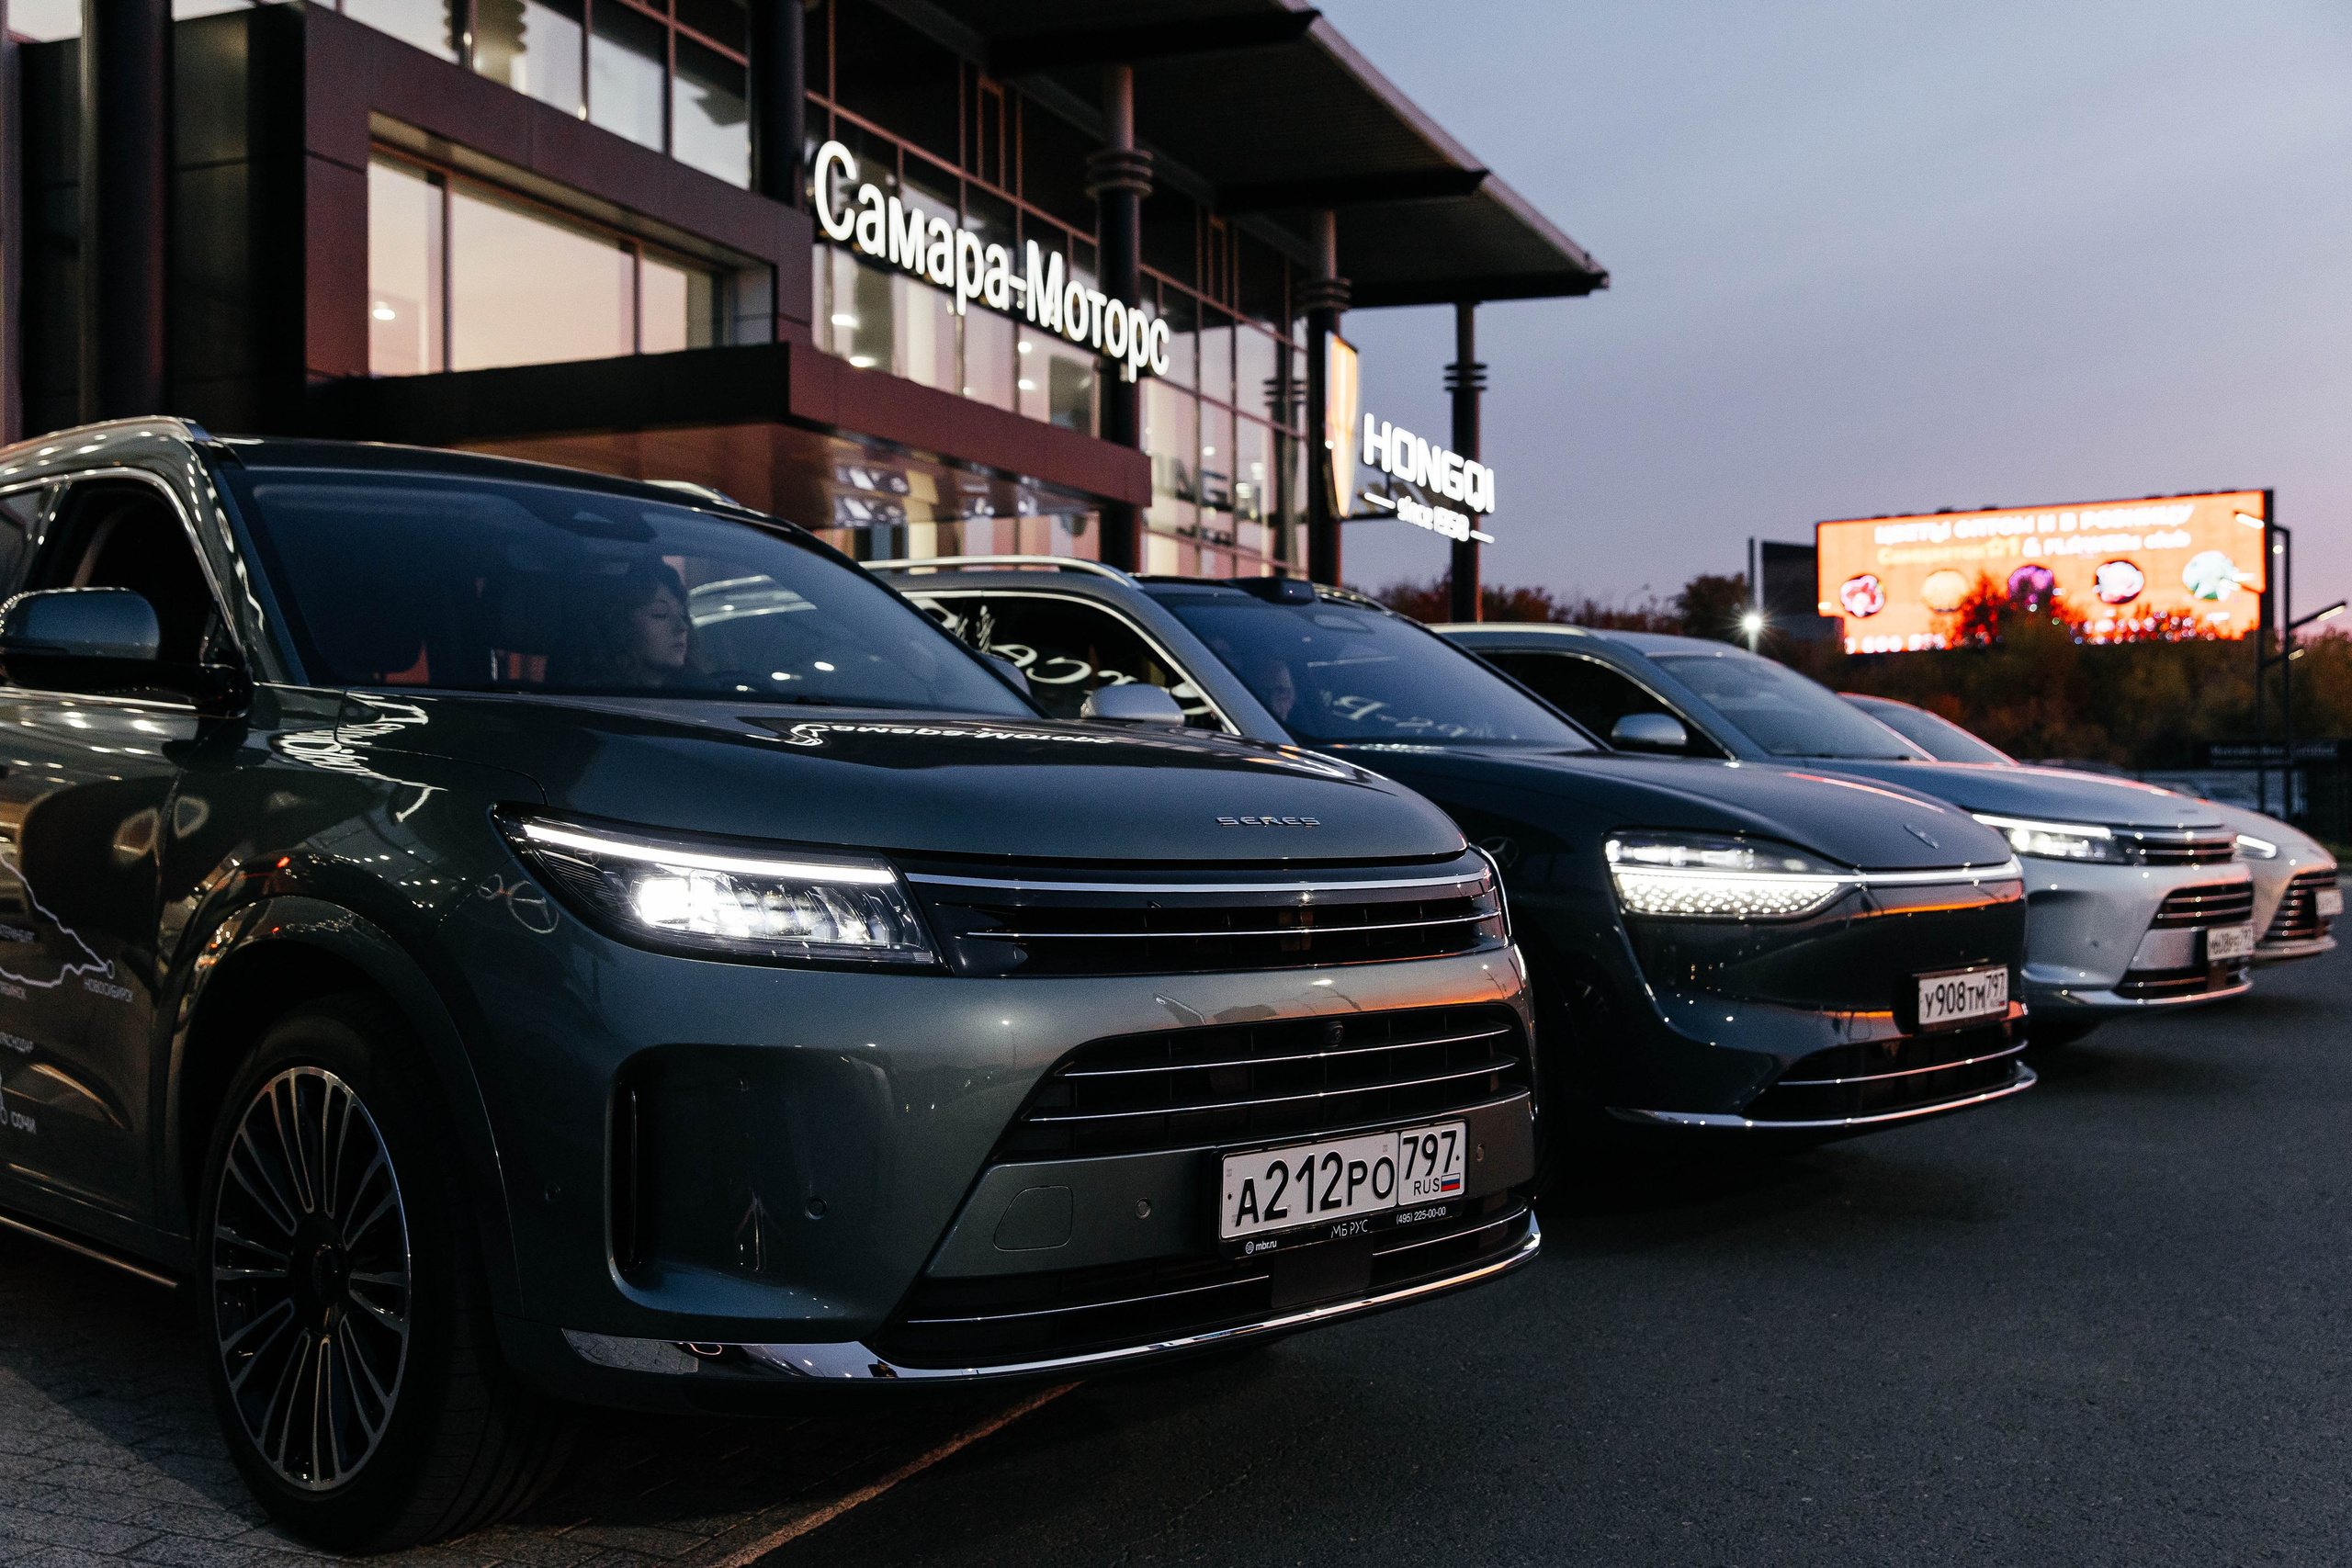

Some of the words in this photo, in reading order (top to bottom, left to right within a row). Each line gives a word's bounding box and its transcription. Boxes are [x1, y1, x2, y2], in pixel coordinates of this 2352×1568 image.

[815, 141, 1170, 382] Самара-Моторс
[1363, 412, 1495, 513] HONGQI
[1216, 817, 1321, 828] SERES
[1925, 981, 1985, 1018] У908ТМ
[1985, 973, 2005, 998] 797
[1235, 1150, 1395, 1227] А212РО
[1403, 1130, 1456, 1179] 797
[1413, 1178, 1440, 1196] RUS
[1396, 1214, 1413, 1225] (495)
[1413, 1206, 1447, 1222] 225-00-00
[1331, 1224, 1348, 1239] МБ
[1350, 1219, 1369, 1235] РУС
[1255, 1240, 1277, 1251] mbr.ru
